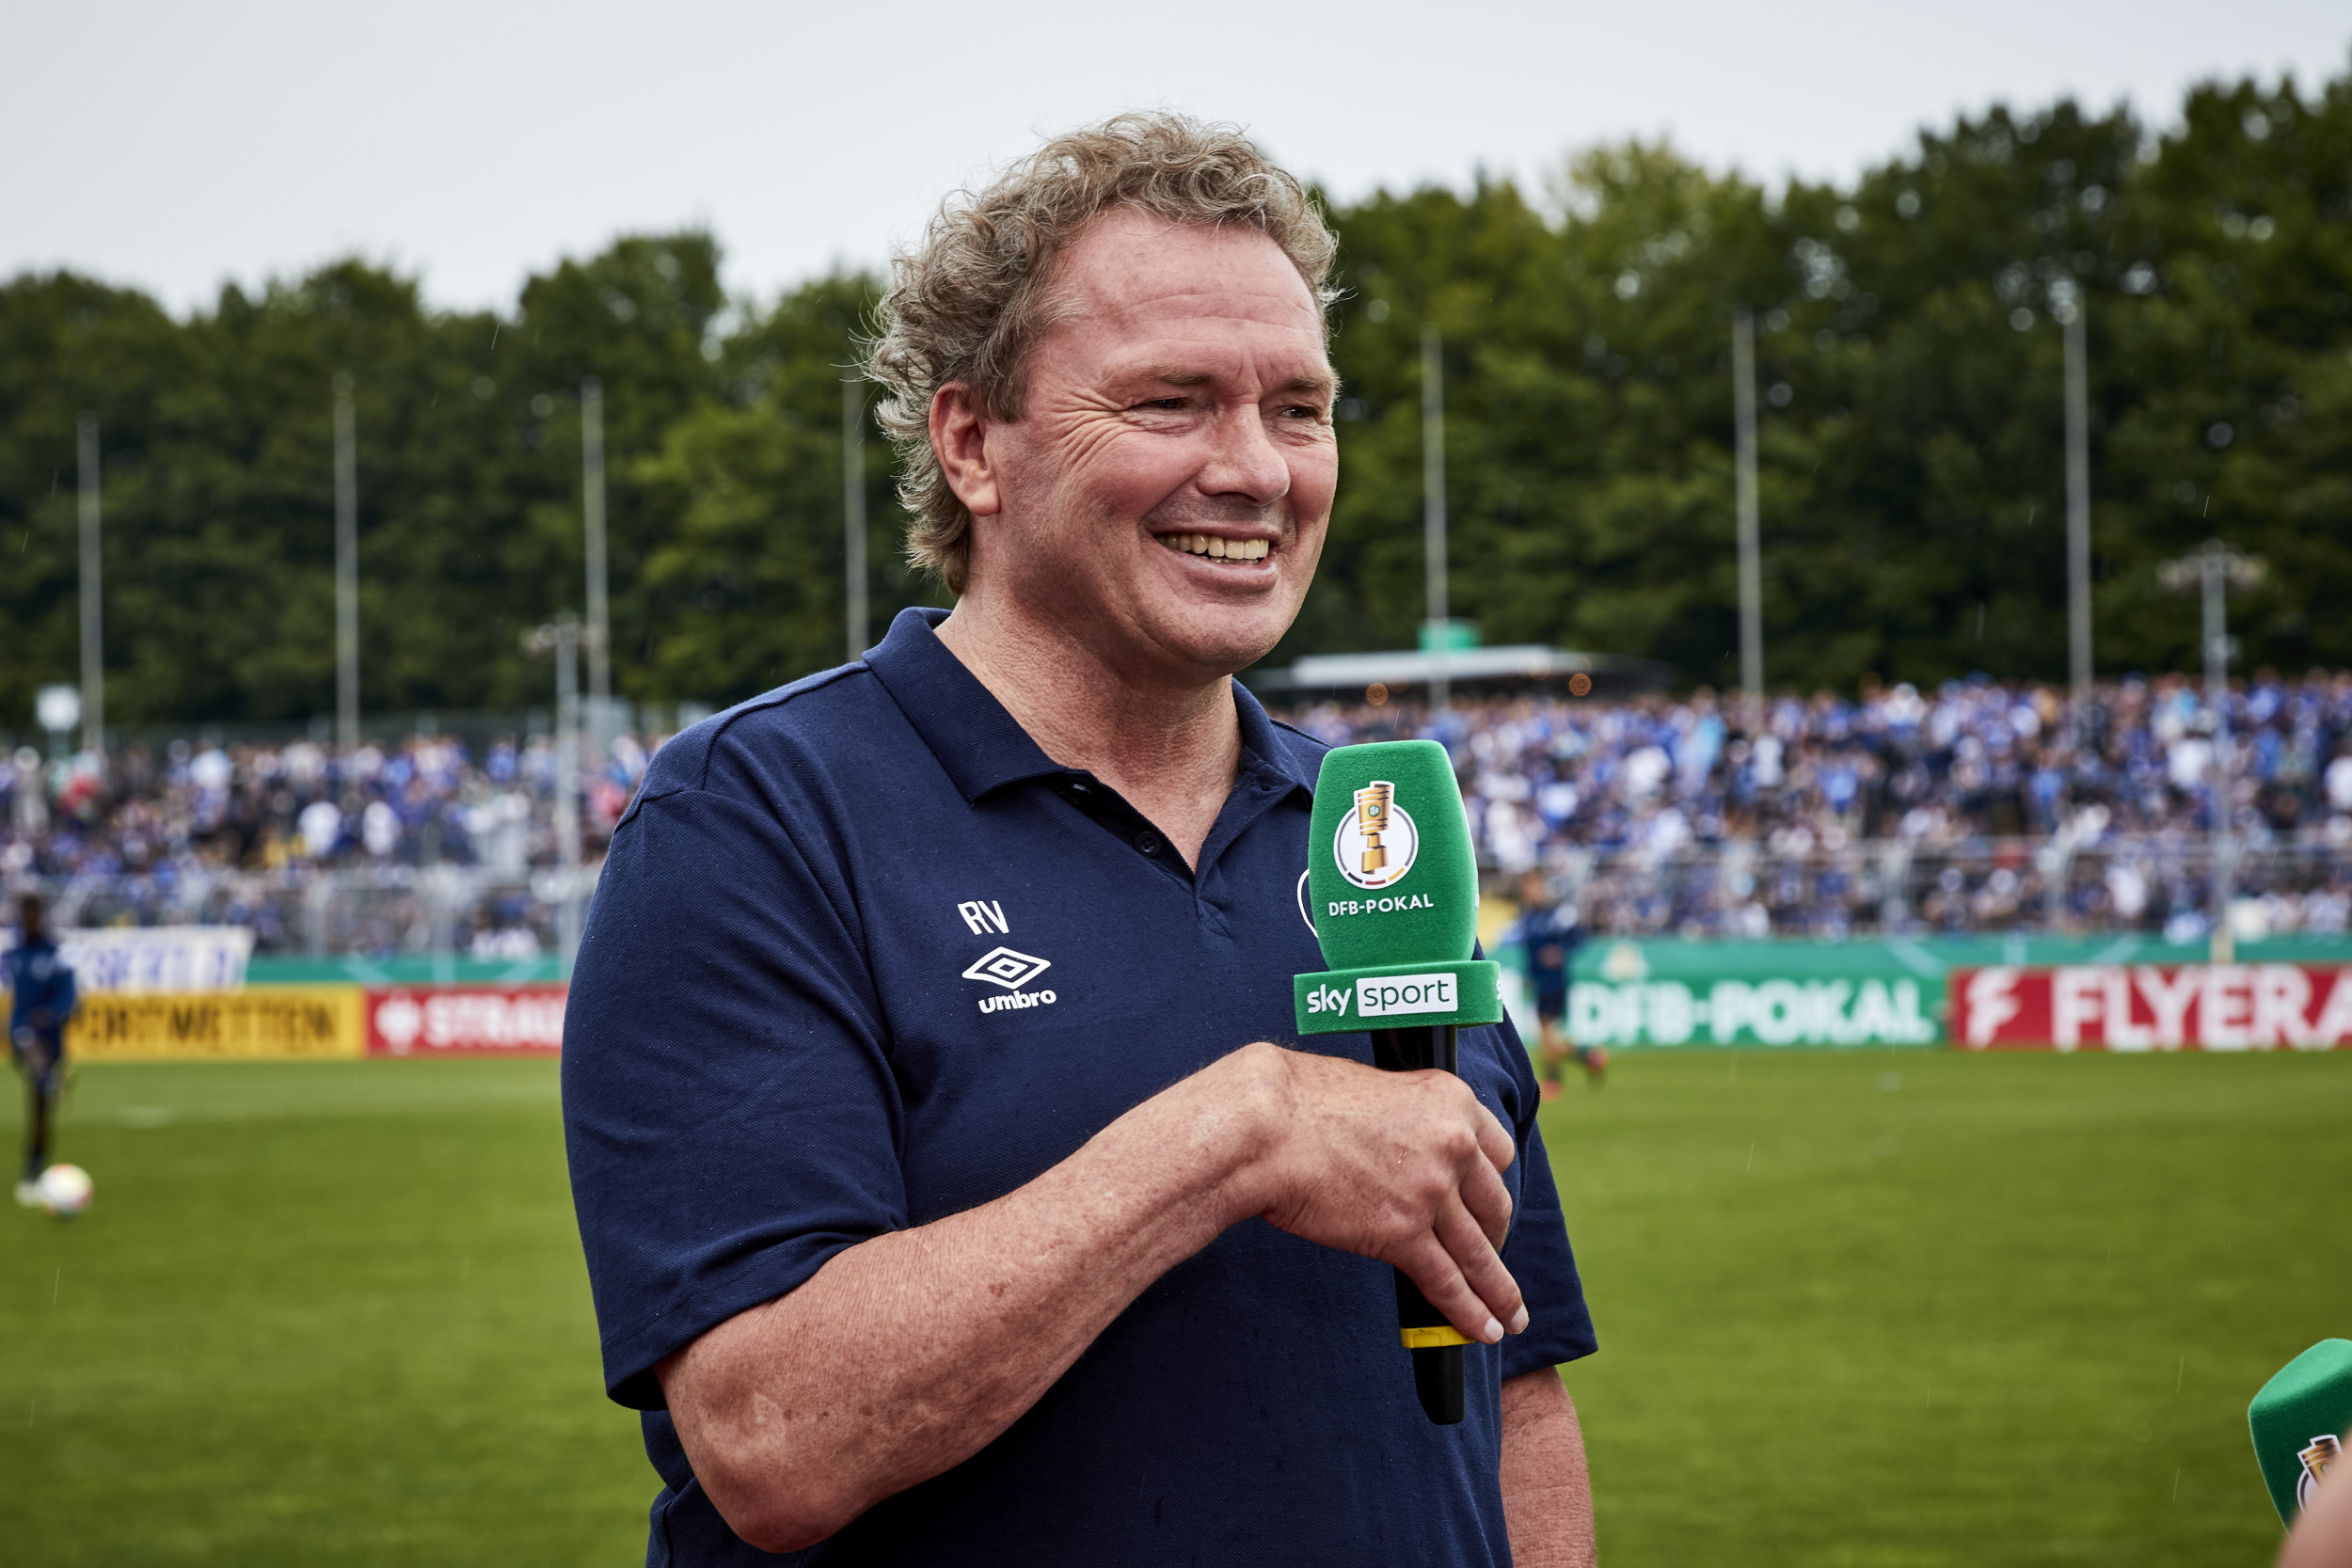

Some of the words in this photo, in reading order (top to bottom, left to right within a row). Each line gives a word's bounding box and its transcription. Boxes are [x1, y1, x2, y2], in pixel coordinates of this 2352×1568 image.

[958, 900, 1009, 935] RV
[1328, 894, 1434, 916] DFB-POKAL
[978, 990, 1057, 1013] umbro
[1307, 984, 1352, 1017] sky
[1363, 979, 1450, 1011] sport
[1567, 977, 1936, 1045] DFB-POKAL
